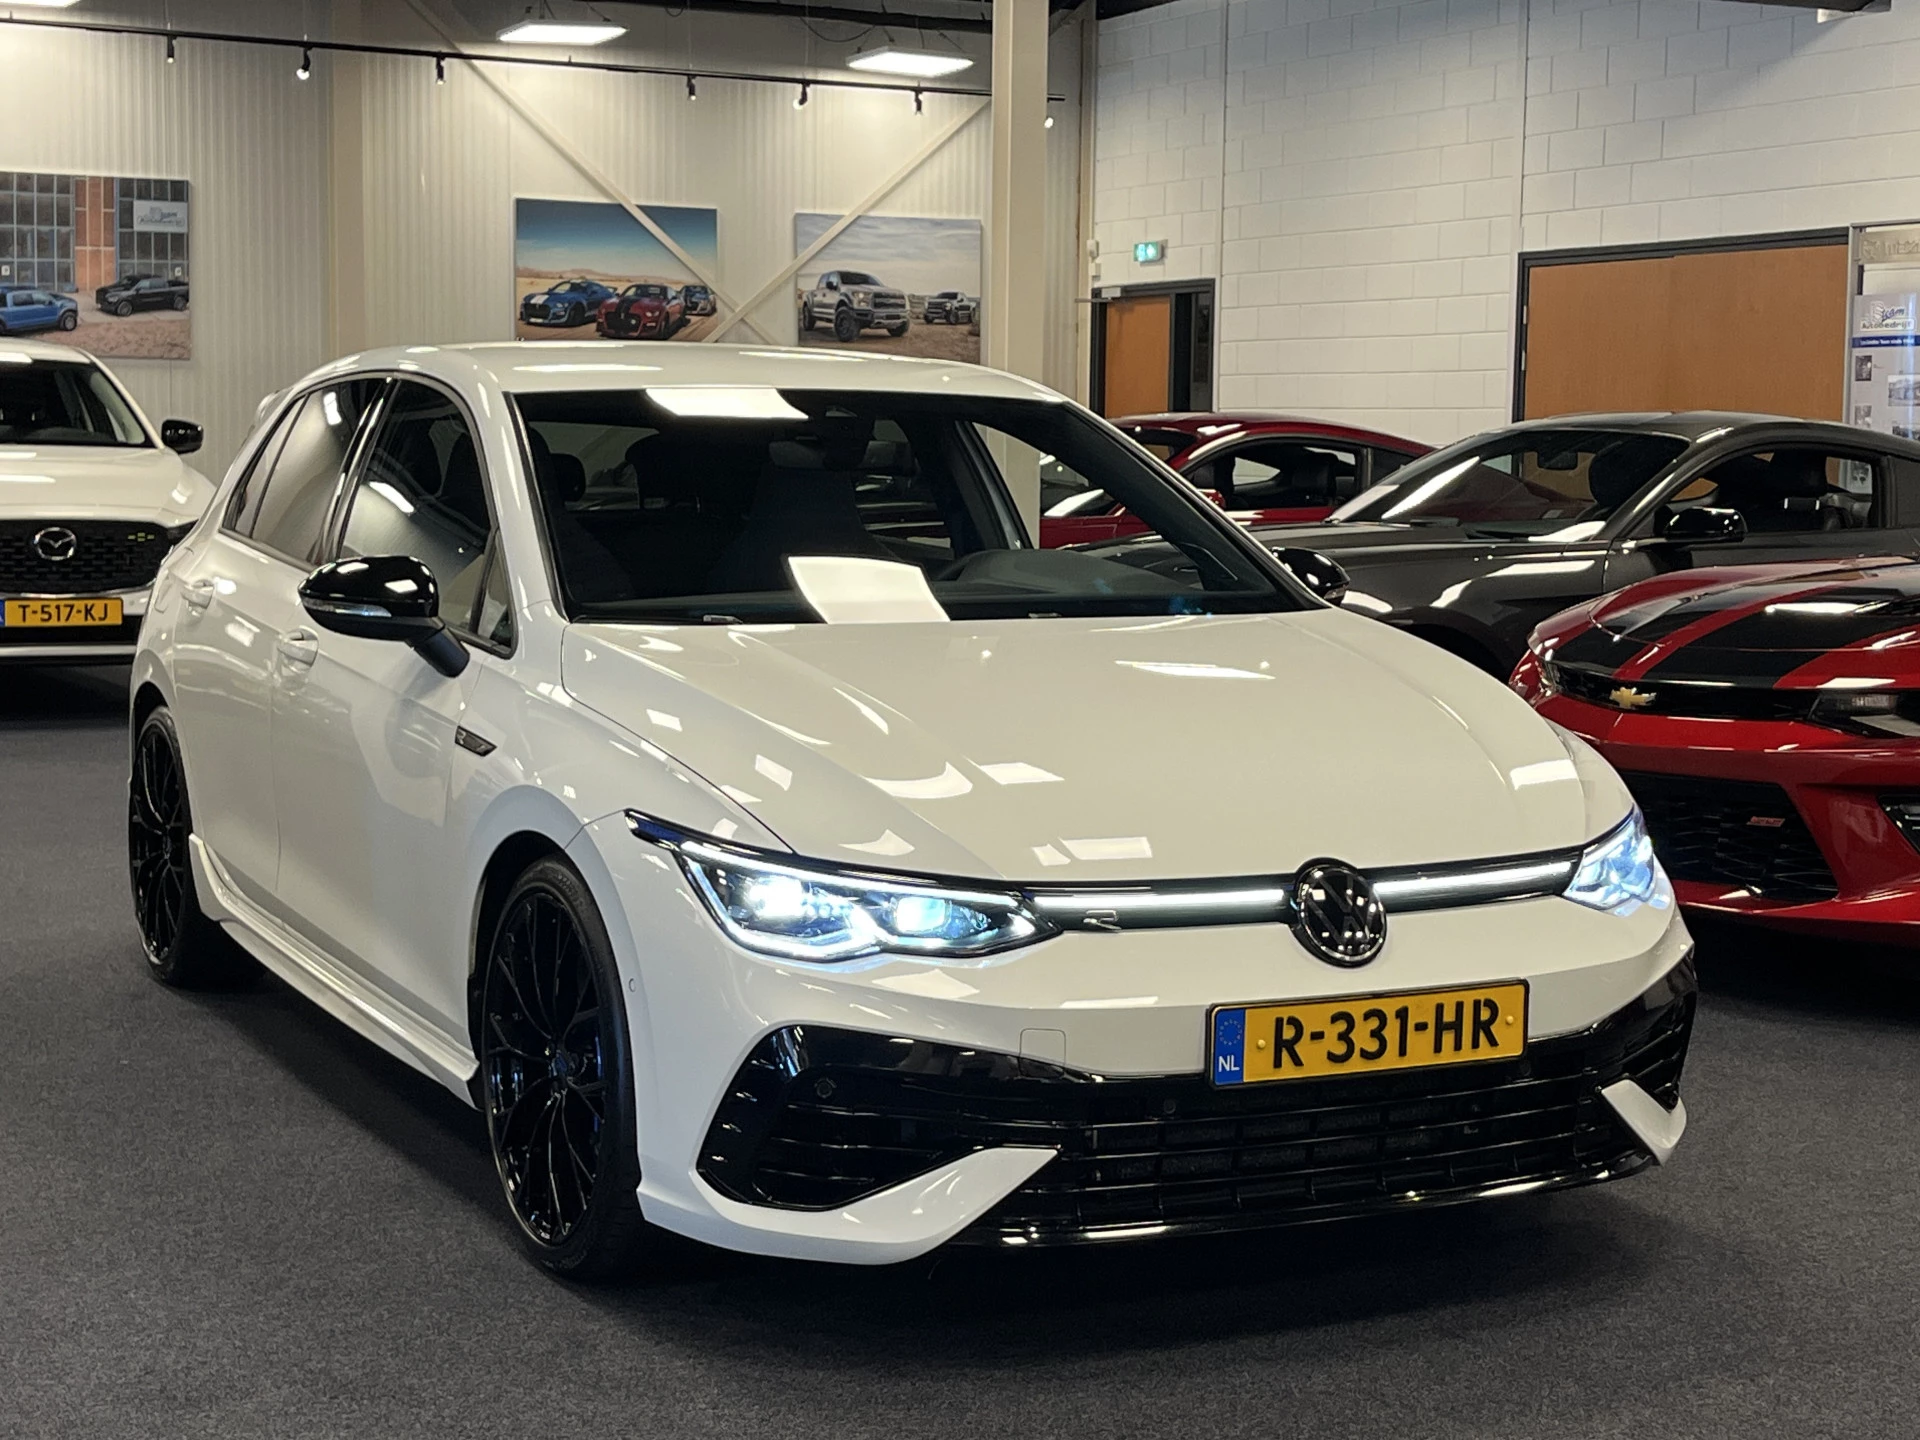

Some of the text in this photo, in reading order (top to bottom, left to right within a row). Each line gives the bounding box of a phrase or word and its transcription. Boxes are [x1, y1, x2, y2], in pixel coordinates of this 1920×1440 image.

[18, 603, 108, 623] T-517-KJ
[1273, 998, 1499, 1069] R-331-HR
[1218, 1055, 1240, 1073] NL
